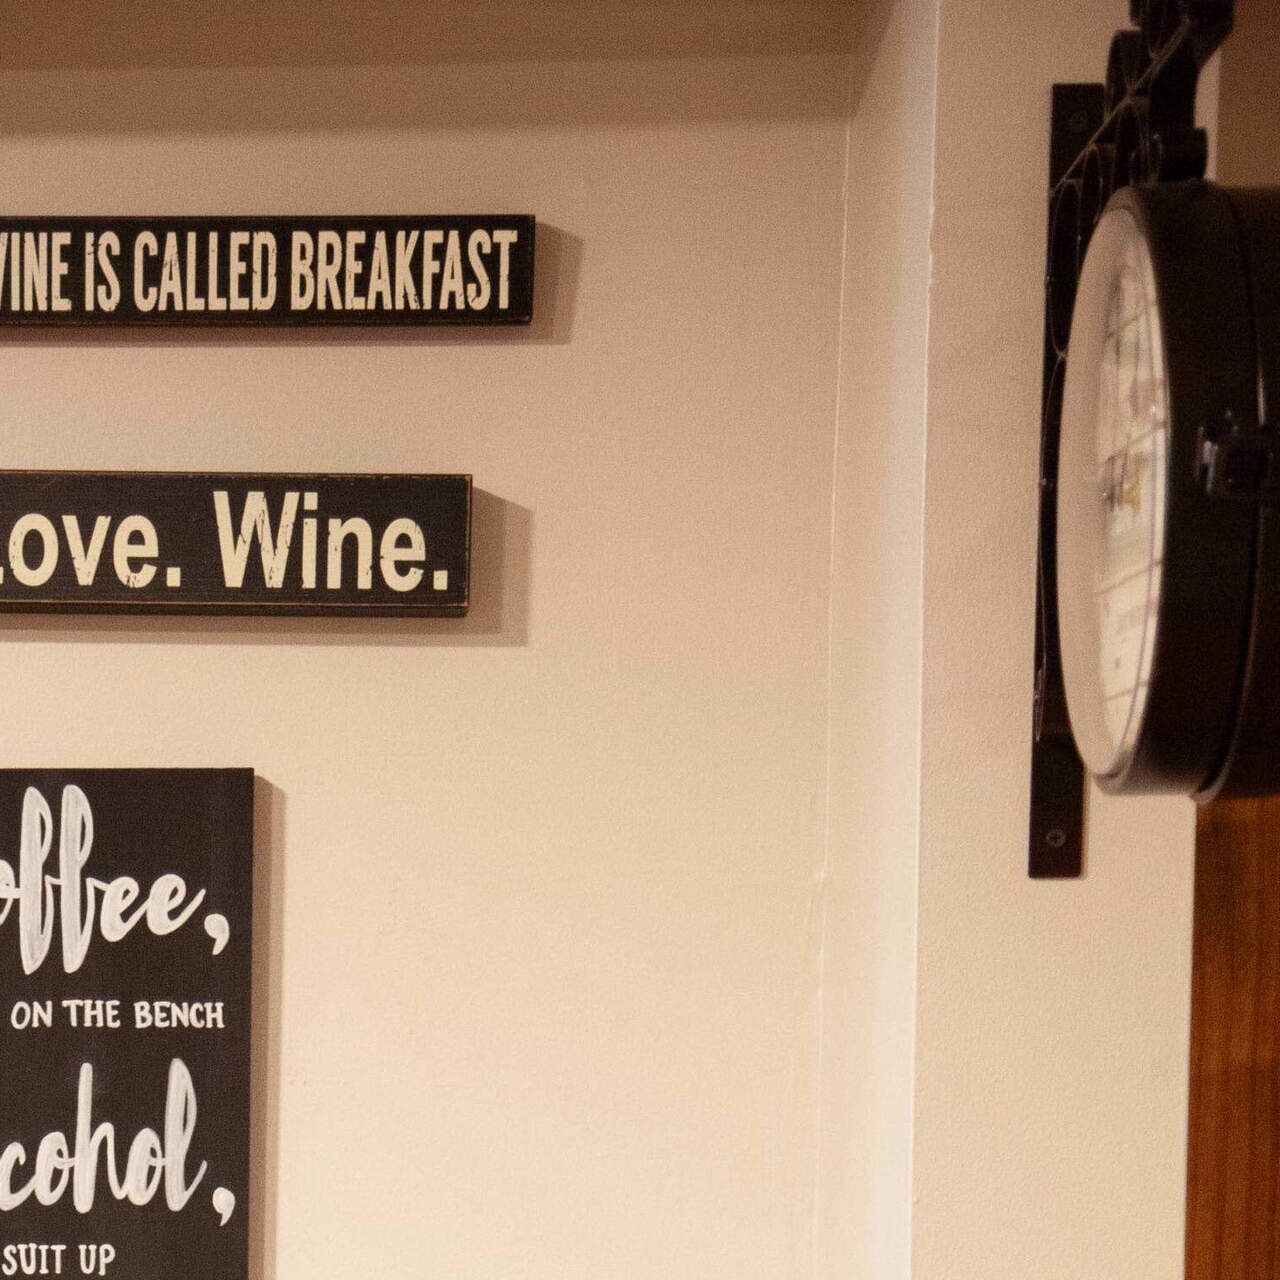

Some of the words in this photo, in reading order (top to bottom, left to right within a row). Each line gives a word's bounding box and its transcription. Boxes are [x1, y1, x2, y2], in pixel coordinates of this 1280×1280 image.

[84, 230, 121, 312] IS
[133, 230, 278, 312] CALLED
[291, 228, 519, 312] BREAKFAST
[213, 490, 449, 593] Wine.
[10, 999, 54, 1031] ON
[62, 998, 121, 1029] THE
[134, 1000, 226, 1030] BENCH
[1, 1243, 67, 1276] SUIT
[79, 1243, 117, 1276] UP
